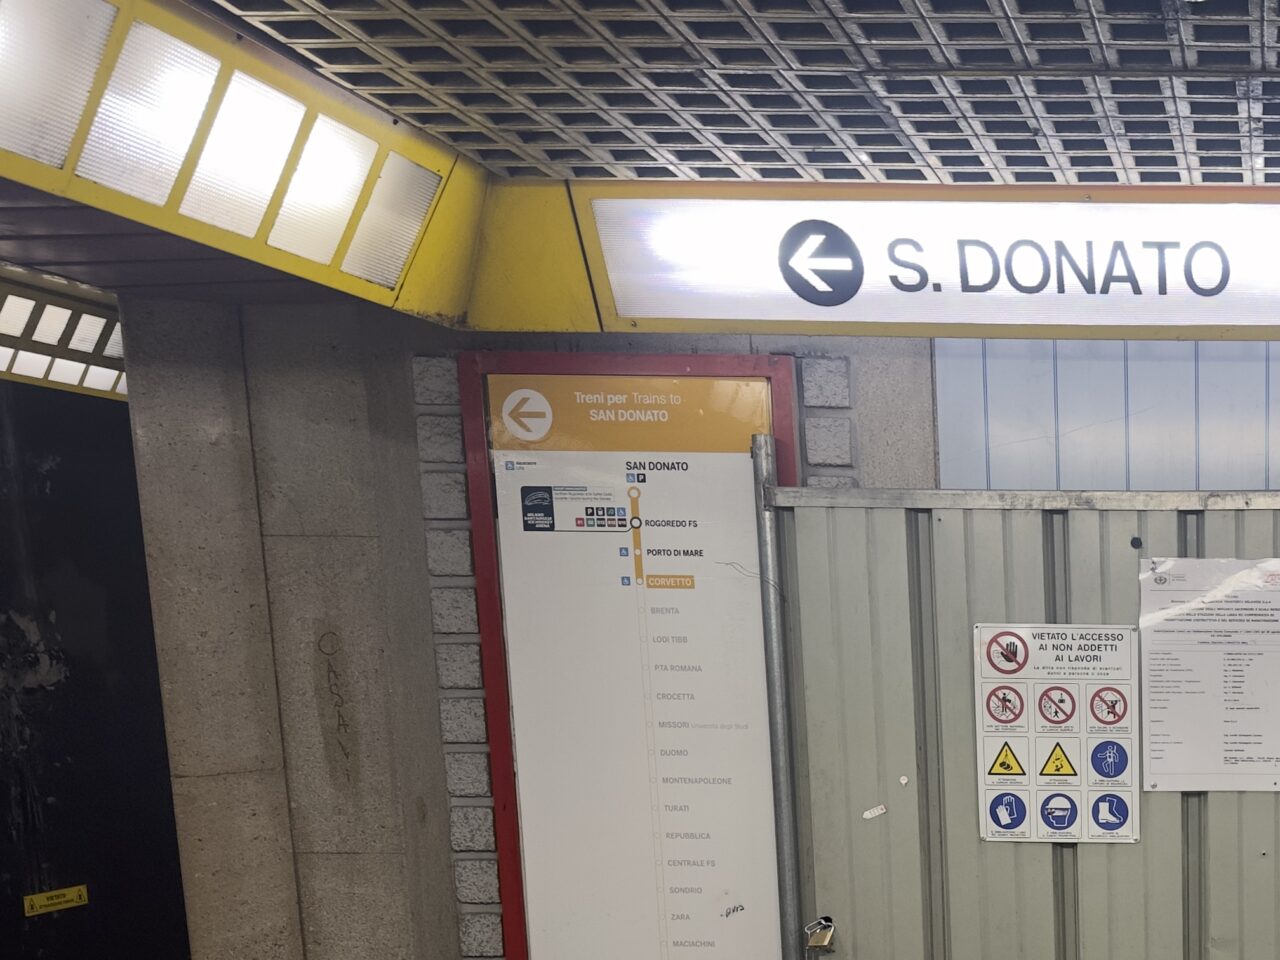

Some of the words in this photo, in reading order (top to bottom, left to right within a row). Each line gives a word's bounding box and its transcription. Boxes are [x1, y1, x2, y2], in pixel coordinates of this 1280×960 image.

[887, 238, 941, 293] S.
[957, 238, 1231, 297] DONATO
[574, 391, 605, 404] Treni
[607, 393, 626, 406] per
[632, 391, 667, 405] Trains
[670, 392, 681, 405] to
[590, 410, 614, 422] SAN
[617, 410, 668, 422] DONATO
[625, 461, 647, 471] SAN
[649, 461, 689, 472] DONATO
[645, 519, 686, 528] ROGOREDO
[688, 519, 698, 528] FS
[646, 548, 671, 557] PORTO
[673, 548, 681, 557] DI
[682, 548, 704, 557] MARE
[648, 577, 692, 586] CORVETTO
[650, 607, 680, 615] BRENTA
[1032, 632, 1068, 641] VIETATO
[1071, 633, 1124, 641] L'ACCESSO
[1039, 643, 1048, 652] AI
[1052, 643, 1073, 652] NON
[1077, 643, 1118, 652] ADDETTI
[1054, 654, 1064, 662] AI
[1068, 654, 1102, 662] LAVORI
[658, 721, 689, 729] MISSORI
[660, 749, 688, 757] DUOMO
[662, 777, 732, 785] MONTENAPOLEONE
[665, 832, 711, 840] REPUBBLICA
[667, 859, 705, 867] CENTRALE
[706, 859, 716, 867] FS
[669, 886, 703, 895] SONDRIO
[671, 913, 690, 921] ZARA
[672, 940, 715, 948] MACIACHINI
